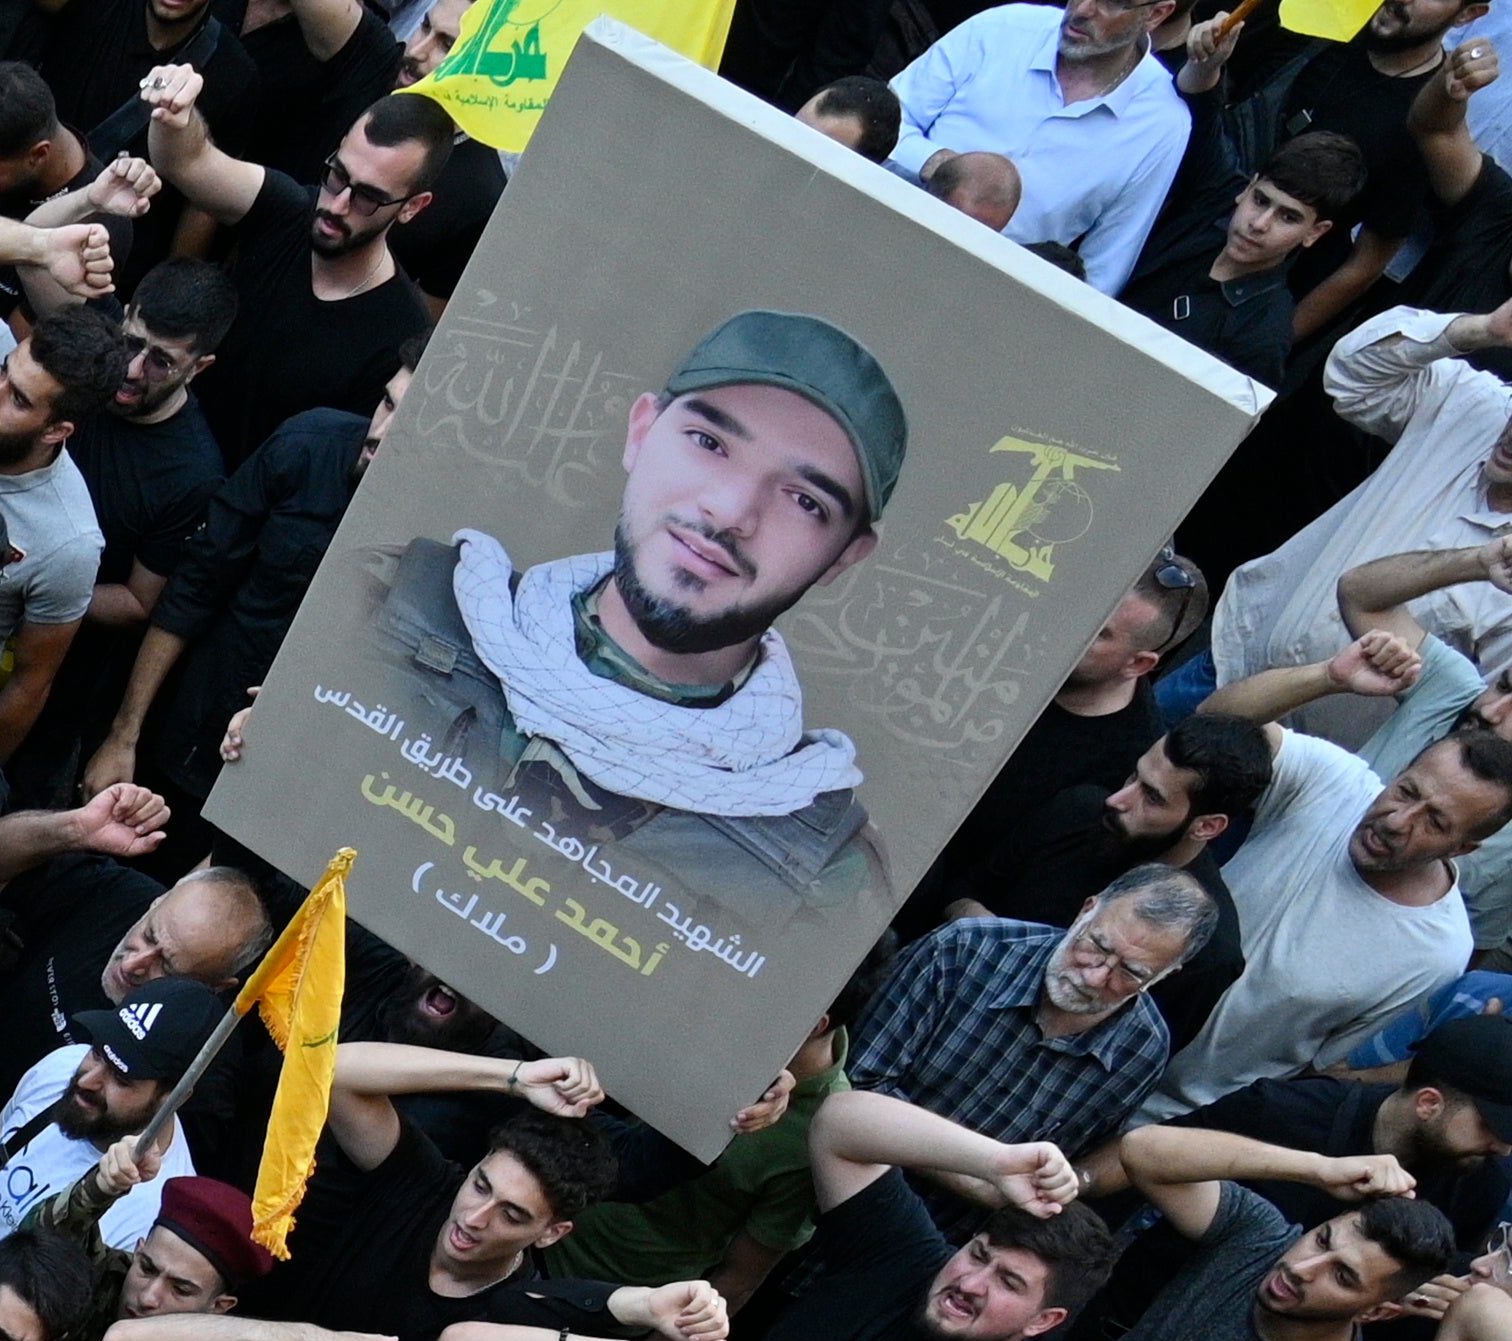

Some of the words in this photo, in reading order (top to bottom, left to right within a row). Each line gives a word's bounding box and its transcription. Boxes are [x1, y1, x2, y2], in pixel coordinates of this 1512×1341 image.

[314, 684, 405, 741] القدس
[400, 732, 473, 790] طريق
[361, 771, 456, 847] حسن
[472, 785, 533, 828] على
[462, 844, 552, 907] علي
[533, 821, 662, 909] المجاهد
[554, 897, 671, 977] أحمد
[656, 901, 766, 978] الشهيد
[119, 1007, 146, 1040] adidas
